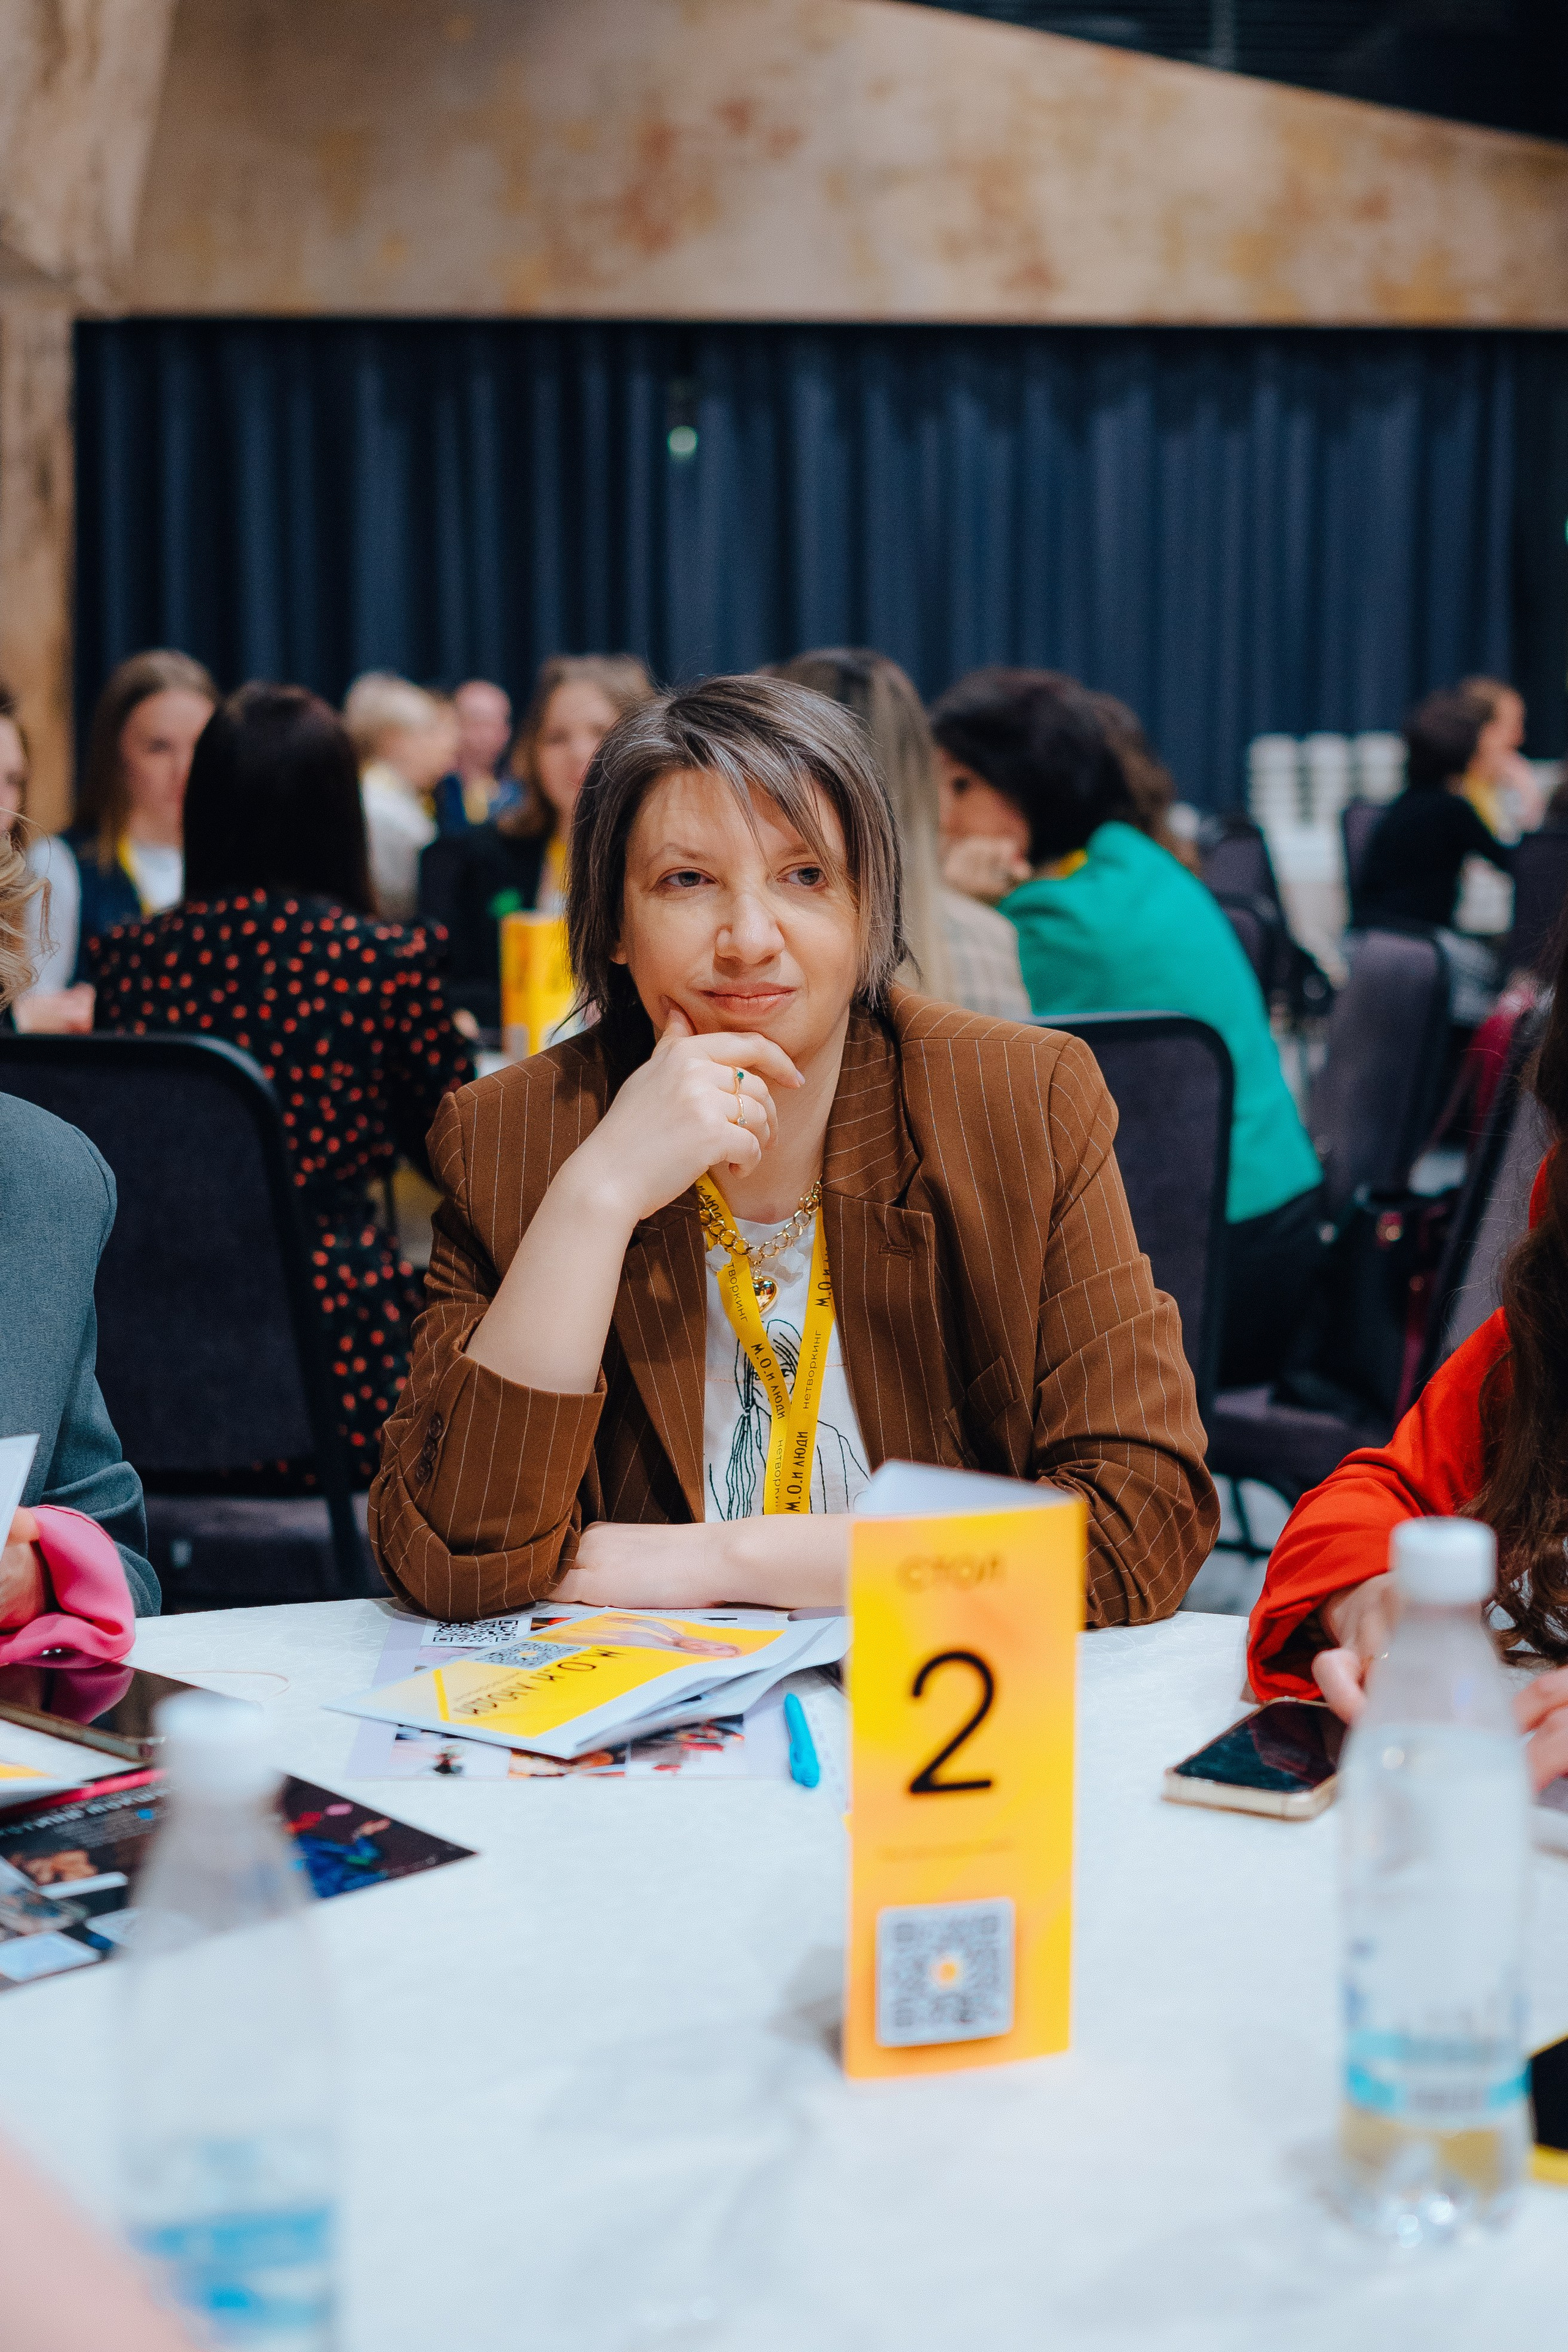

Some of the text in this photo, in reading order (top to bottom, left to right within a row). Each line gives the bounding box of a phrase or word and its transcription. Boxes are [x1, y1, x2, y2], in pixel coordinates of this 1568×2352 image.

[727, 1262, 748, 1322] творкинг
[802, 1330, 822, 1409] нетворкинг
[896, 1553, 1006, 1593] СТОЛ
[910, 1651, 994, 1793] 2
